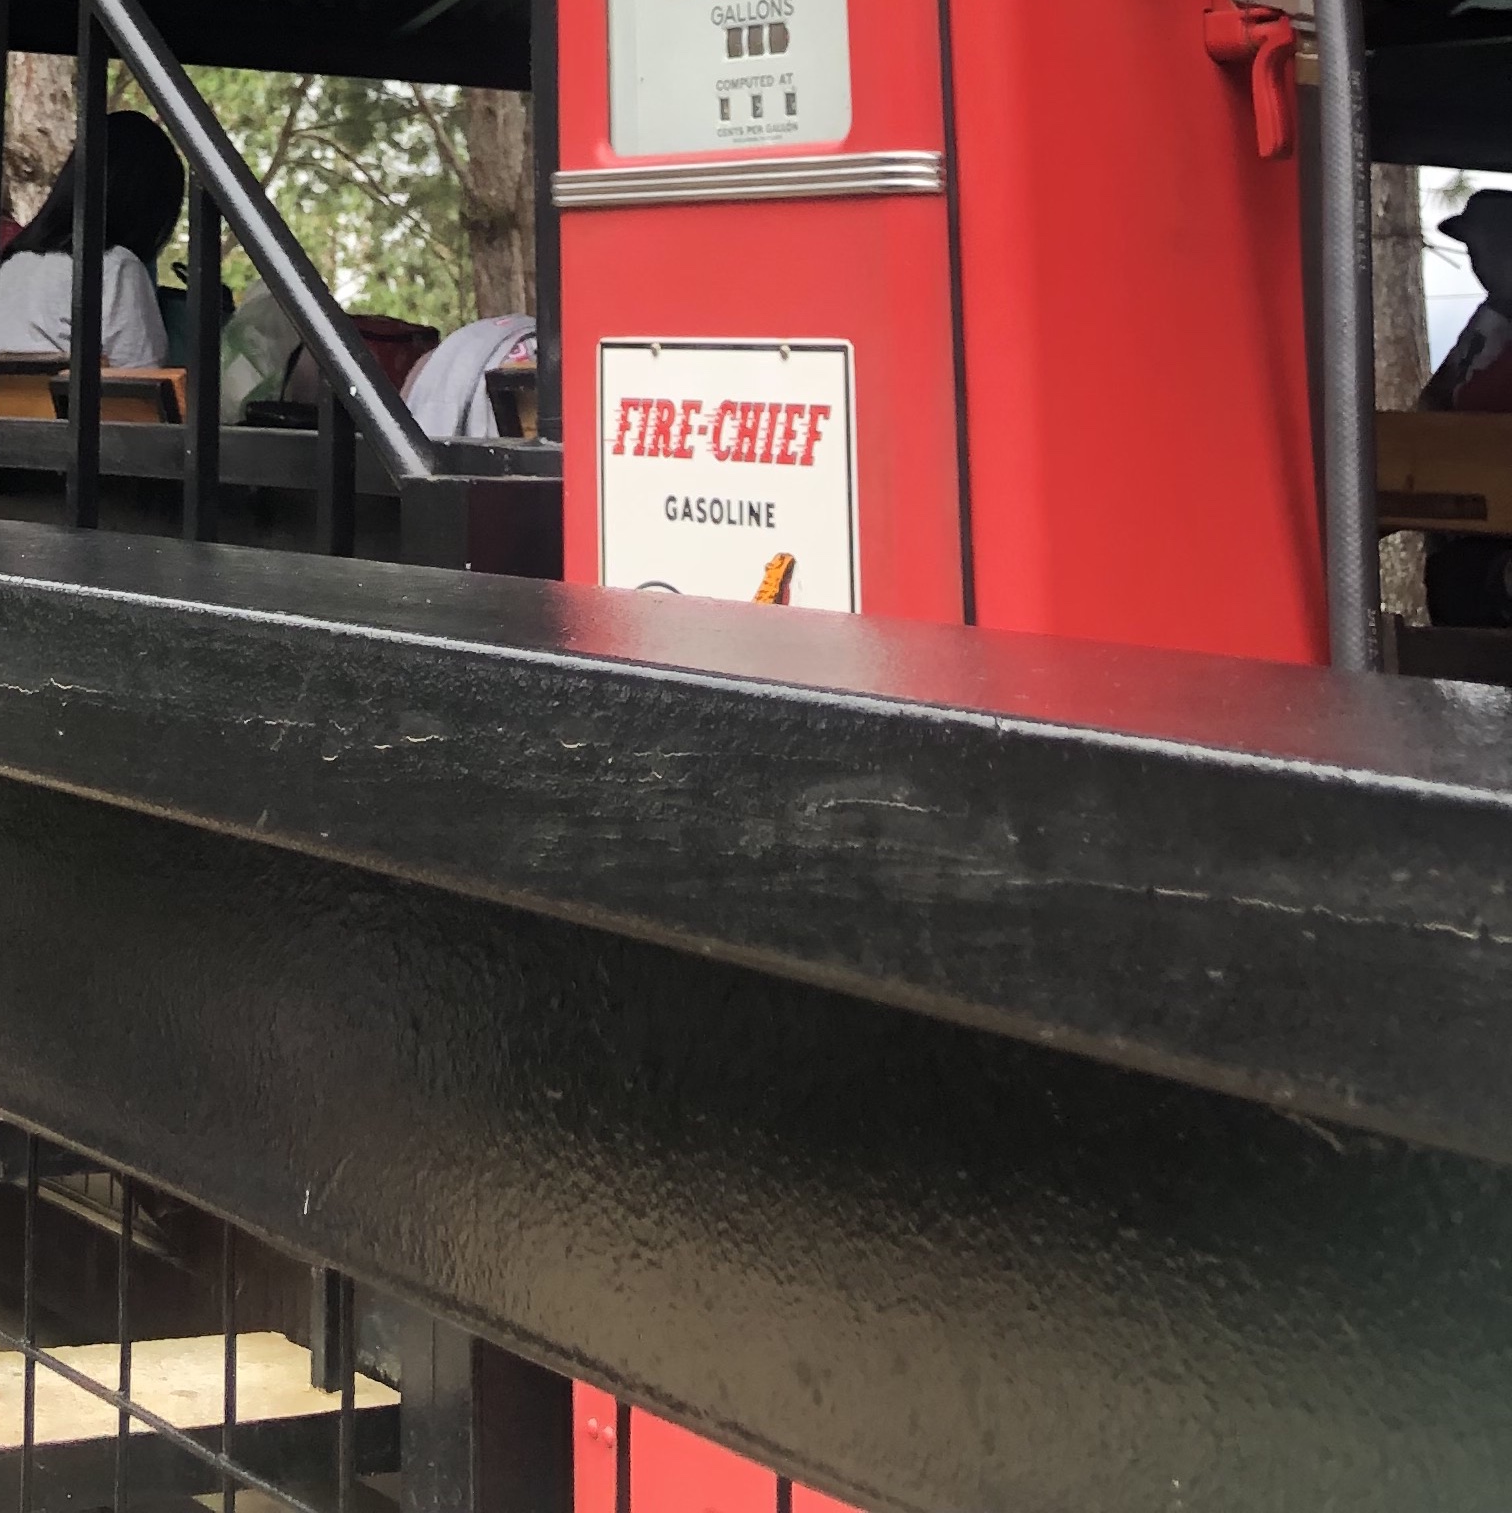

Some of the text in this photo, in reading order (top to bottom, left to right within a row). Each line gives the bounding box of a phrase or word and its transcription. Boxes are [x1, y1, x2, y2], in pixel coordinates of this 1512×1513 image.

[778, 72, 794, 86] AT
[611, 397, 832, 467] FIRE-CHIEF
[664, 495, 777, 528] GASOLINE
